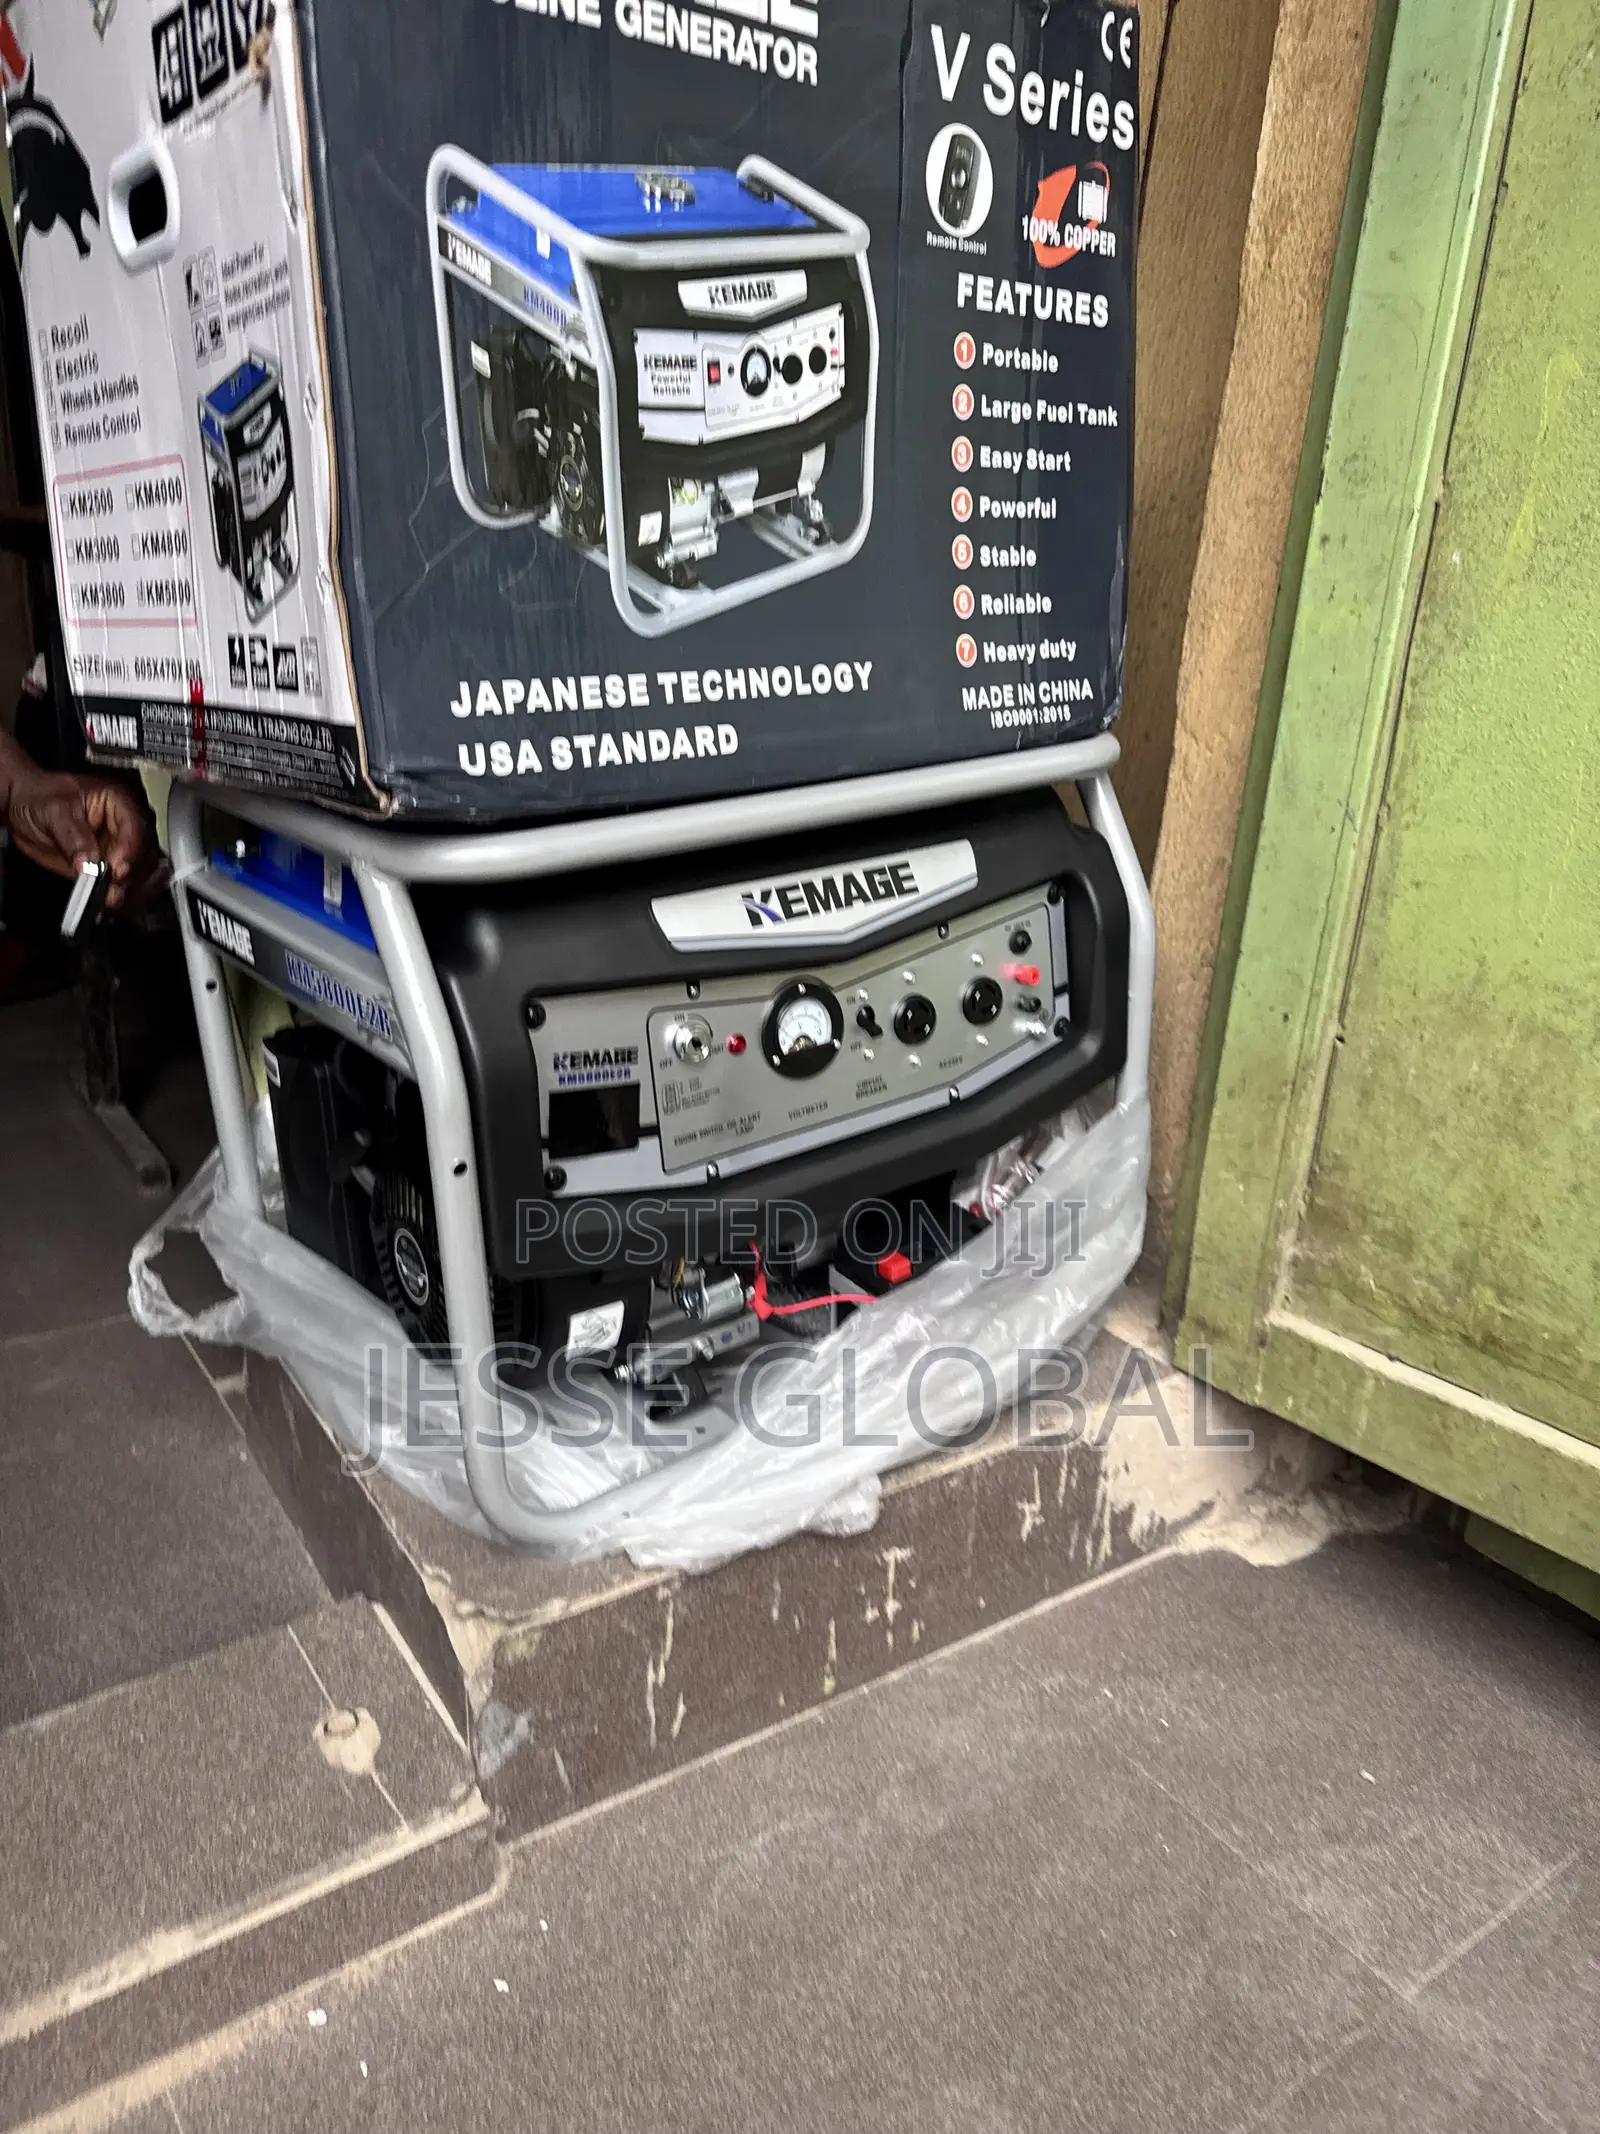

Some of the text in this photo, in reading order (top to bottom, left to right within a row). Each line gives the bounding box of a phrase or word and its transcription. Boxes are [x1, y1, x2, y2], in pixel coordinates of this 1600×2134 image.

[614, 0, 818, 86] GENERATOR
[930, 24, 1135, 151] V Series
[926, 231, 987, 257] Remote Control
[1022, 214, 1117, 258] 100% COPPER
[957, 271, 1109, 329] FEATURES
[50, 312, 89, 353] Recoil
[56, 348, 99, 386] Electric
[983, 342, 1059, 373] Portable
[65, 405, 142, 448] Remote Control
[980, 394, 1032, 425] Large
[1036, 399, 1073, 424] Fuel
[1077, 402, 1118, 428] Tank
[980, 445, 1022, 474] Easy
[1026, 448, 1071, 472] Start
[134, 476, 182, 511] KM4000
[979, 495, 1057, 520] Powerful
[141, 527, 188, 560] KM4800
[979, 545, 1037, 568] Stable
[981, 592, 1052, 616] Reliable
[983, 640, 1035, 665] Heavy
[1040, 638, 1077, 662] duty
[450, 661, 873, 719] JAPANESE TECHNOLOGY
[962, 678, 1094, 711] MADE IN CHINA
[458, 723, 739, 777] USA STANDARD
[740, 859, 920, 929] KEMAGE
[553, 1046, 639, 1072] KEMAGE
